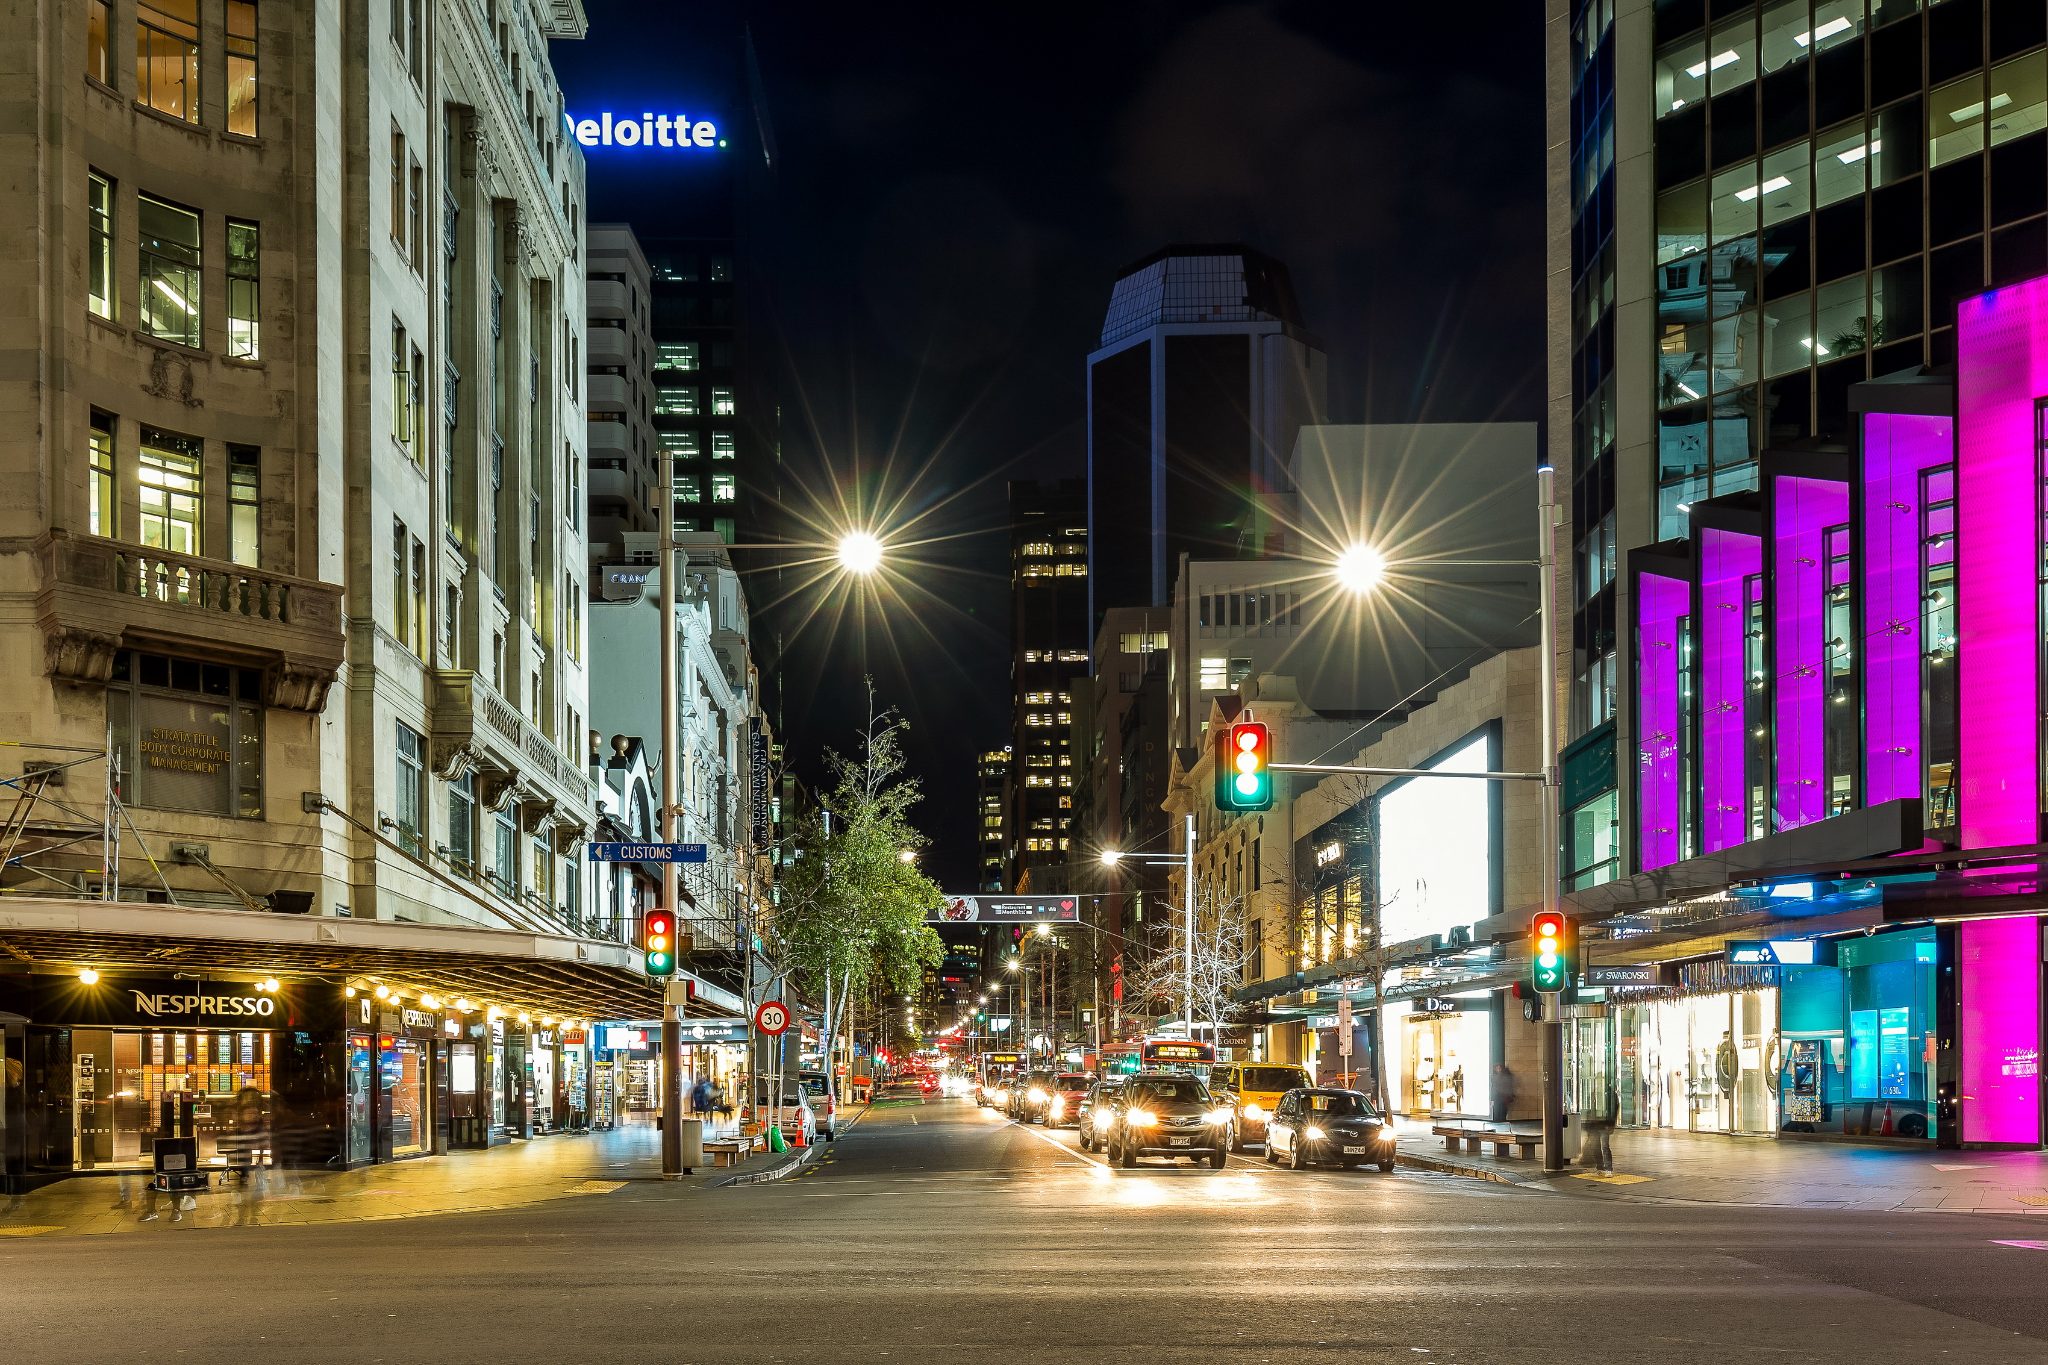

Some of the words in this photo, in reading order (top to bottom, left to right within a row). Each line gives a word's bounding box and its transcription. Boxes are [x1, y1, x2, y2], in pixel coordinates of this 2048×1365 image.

[153, 728, 190, 743] STRATA
[192, 732, 219, 747] TITLE
[140, 741, 168, 754] BODY
[171, 744, 231, 762] CORPORATE
[151, 755, 221, 774] MANAGEMENT
[621, 846, 672, 859] CUSTOMS
[1606, 971, 1650, 980] SWAROVSKI
[128, 989, 275, 1017] NESPRESSO
[1427, 998, 1455, 1011] Dior
[400, 1005, 434, 1028] NESPRESSO
[764, 1012, 782, 1025] 30
[1316, 1017, 1361, 1027] PRAA
